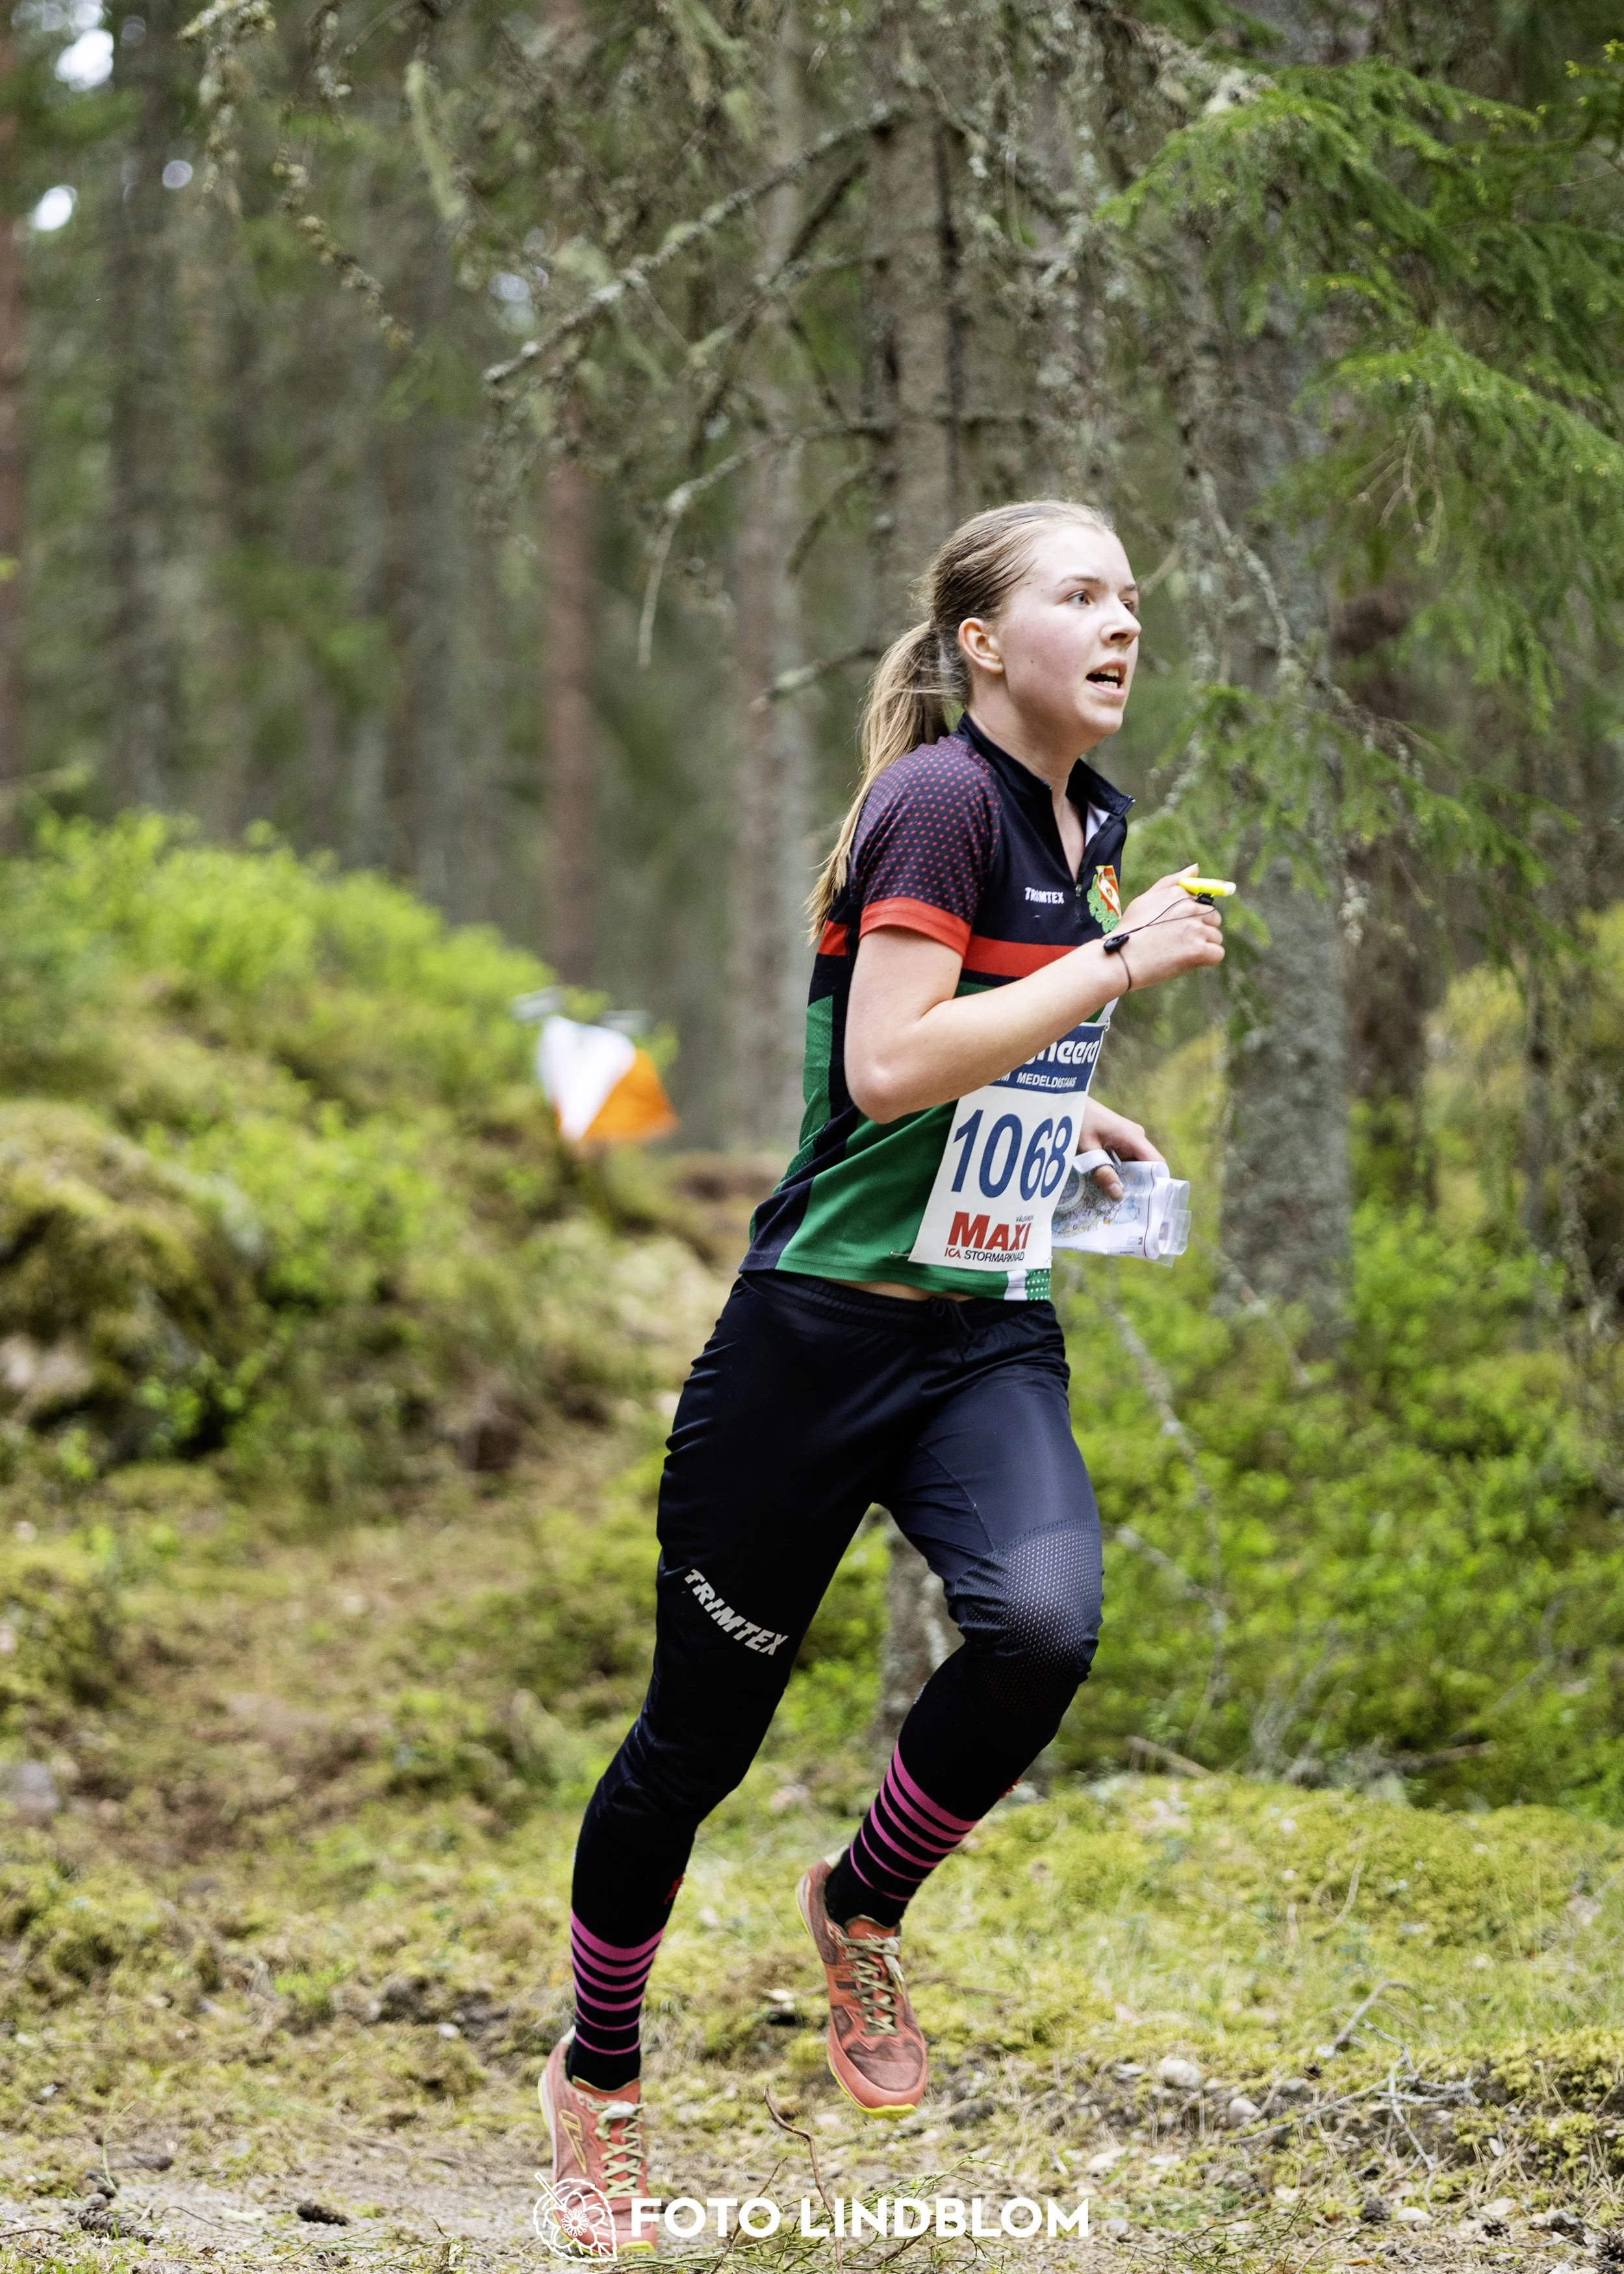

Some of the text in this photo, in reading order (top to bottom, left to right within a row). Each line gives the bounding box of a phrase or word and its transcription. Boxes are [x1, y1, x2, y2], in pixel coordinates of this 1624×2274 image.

[1024, 886, 1065, 904] TRIMTEX
[1016, 1071, 1077, 1088] MEDELDISTANS
[951, 1109, 1072, 1201] 1068
[947, 1211, 1032, 1251] MAXI
[944, 1247, 1024, 1262] ICA STORMARKNAD
[684, 1568, 789, 1655] TRIMTEX
